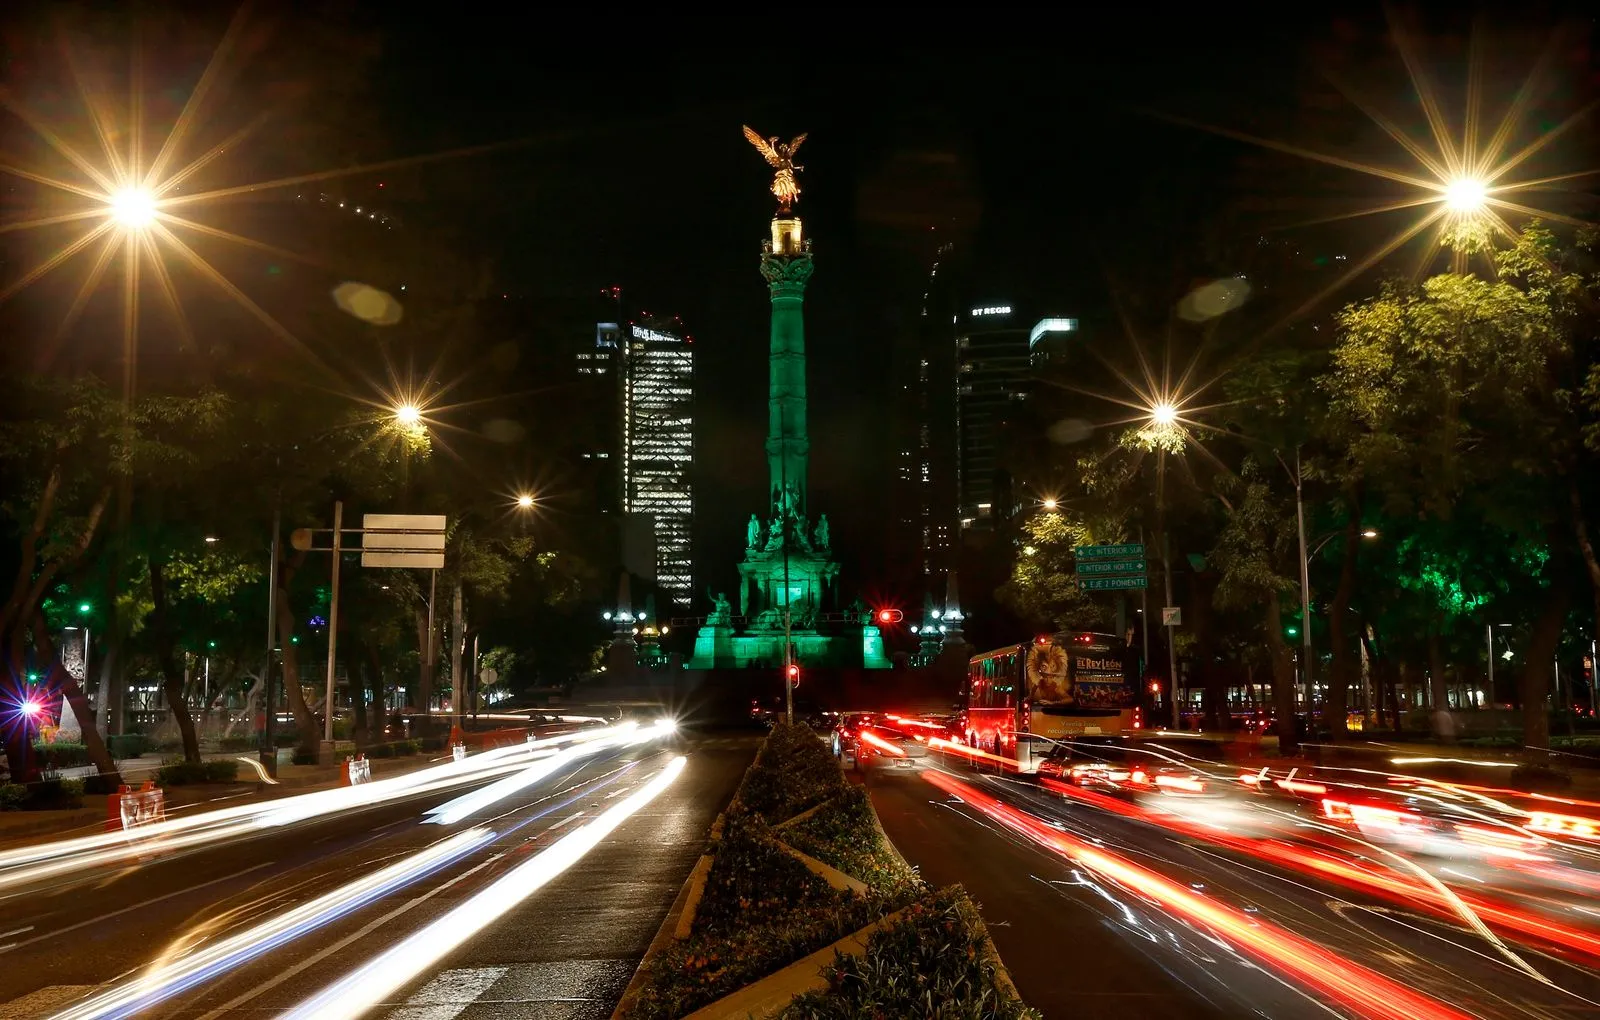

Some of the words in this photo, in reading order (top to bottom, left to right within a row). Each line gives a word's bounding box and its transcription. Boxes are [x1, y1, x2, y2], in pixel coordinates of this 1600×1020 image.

[972, 308, 983, 316] ST
[984, 306, 1011, 315] REGIS
[1097, 547, 1127, 555] INTERIOR
[1130, 546, 1142, 554] SUR
[1086, 563, 1111, 572] INTERIOR
[1113, 562, 1133, 571] NORTE
[1090, 580, 1102, 588] EJE
[1112, 579, 1145, 587] PONIENTE
[1086, 658, 1101, 669] REY
[1101, 658, 1122, 670] LEÓN
